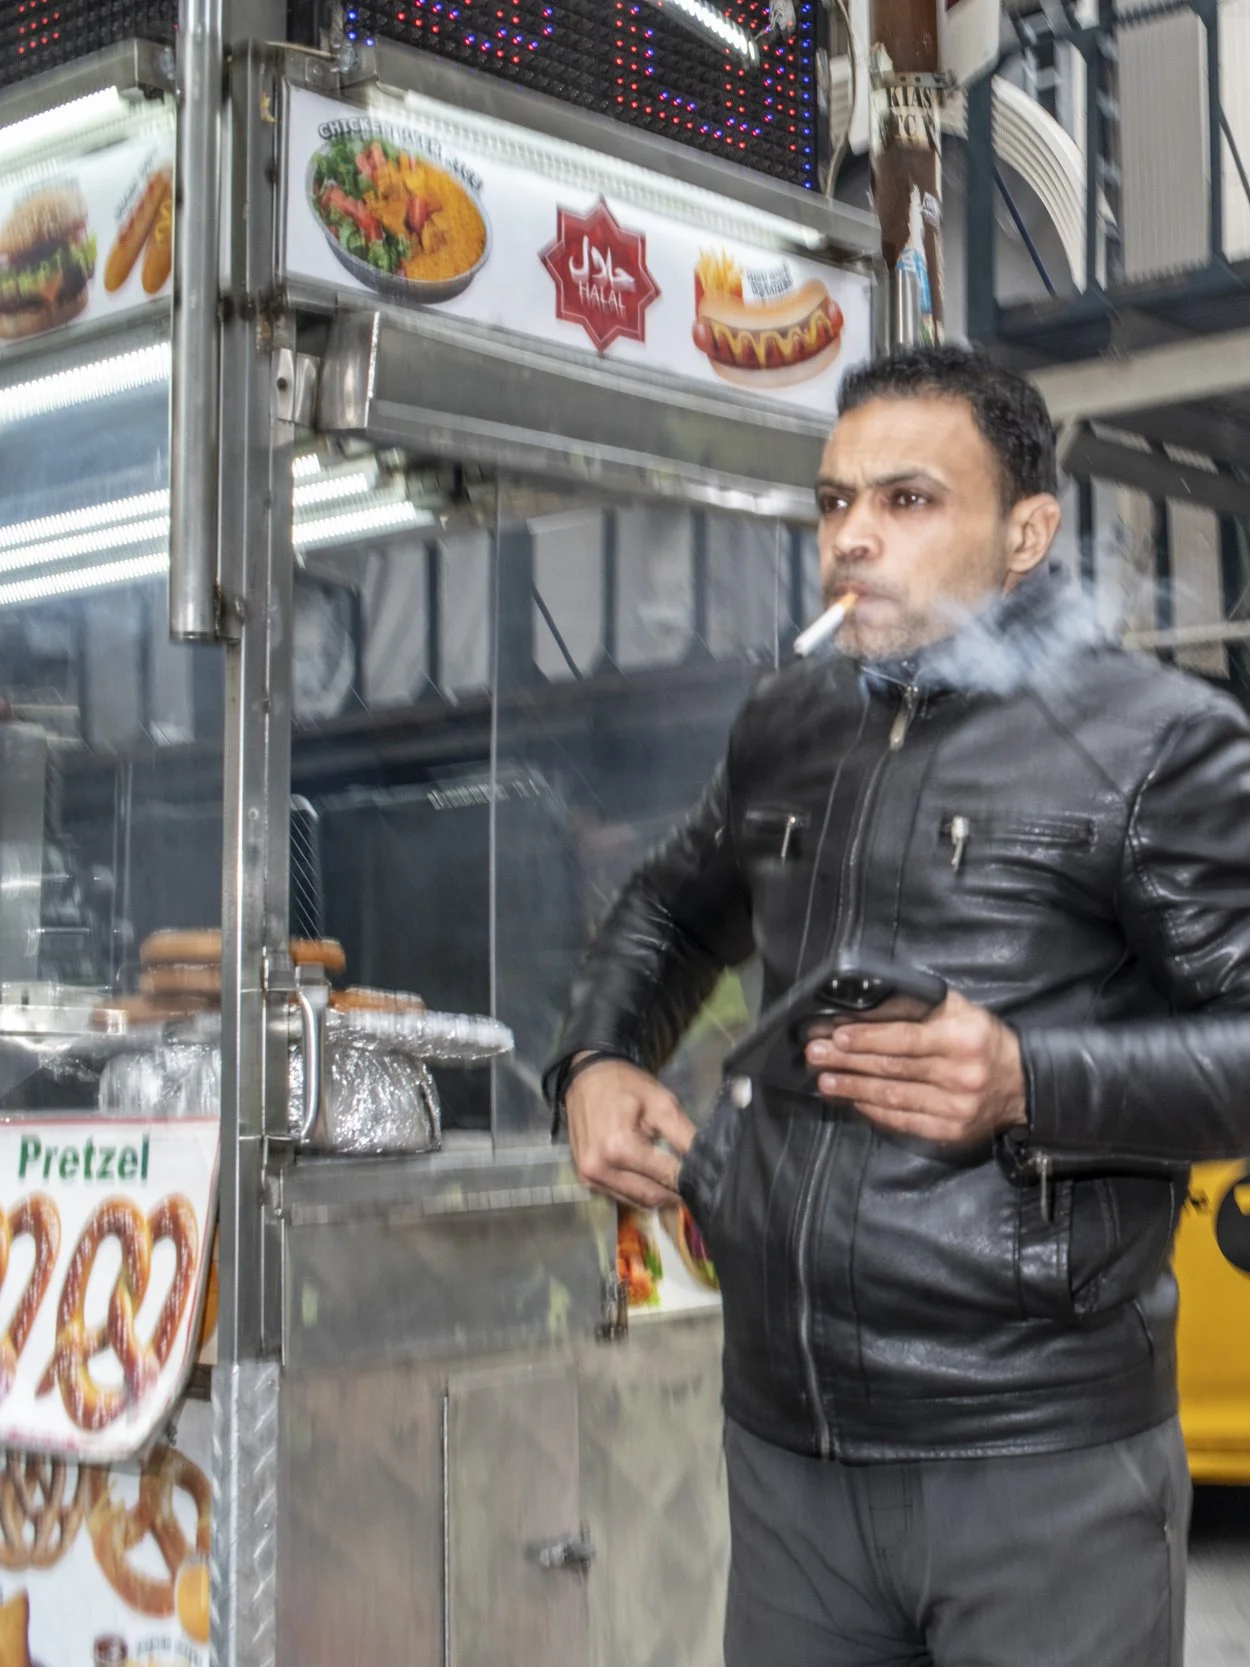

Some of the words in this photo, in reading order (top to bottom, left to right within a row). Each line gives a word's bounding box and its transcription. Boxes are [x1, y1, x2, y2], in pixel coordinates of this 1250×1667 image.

[568, 235, 636, 284] حلال
[578, 279, 627, 312] HALAL
[18, 1134, 150, 1180] Pretzel
